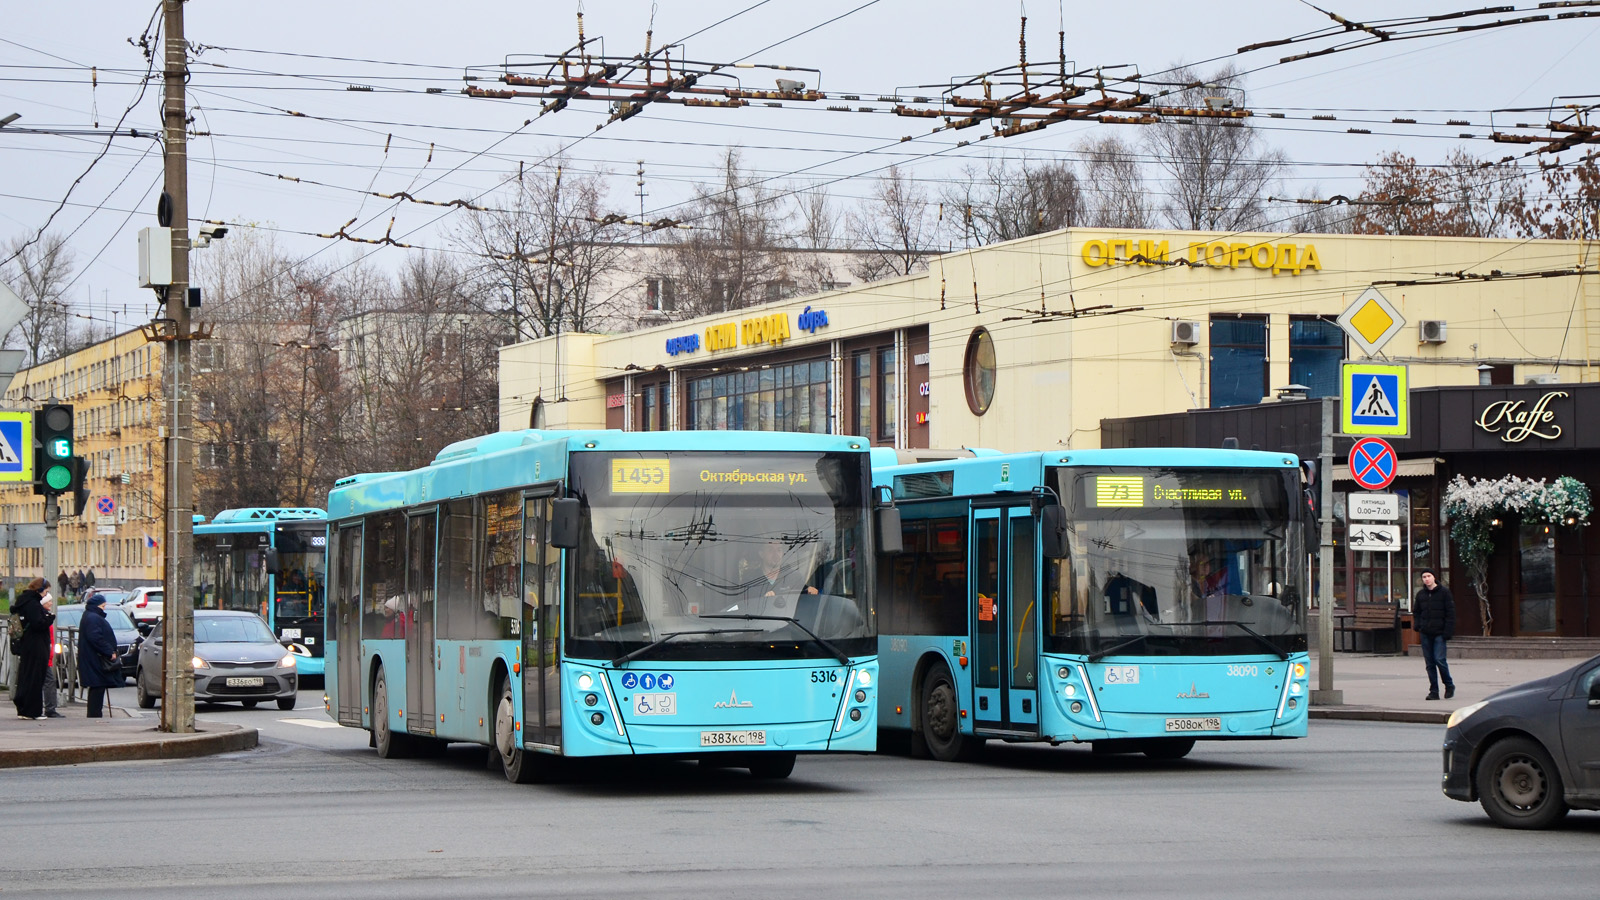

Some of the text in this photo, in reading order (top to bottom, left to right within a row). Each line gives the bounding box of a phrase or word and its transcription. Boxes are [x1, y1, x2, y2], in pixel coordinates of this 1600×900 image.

[1081, 239, 1322, 275] ОГНИ ГОРОДА
[705, 312, 790, 352] ОГНИ ГОРОДА
[1475, 391, 1569, 442] Kaffe
[55, 440, 70, 457] 16
[699, 469, 785, 485] Октябрьская
[787, 472, 808, 485] ул.
[1110, 484, 1247, 500] 73 Счастливая ул.
[312, 536, 326, 546] 333
[810, 670, 837, 683] 5316
[1226, 665, 1258, 677] 38090
[1205, 718, 1218, 727] 198
[747, 732, 763, 740] 198
